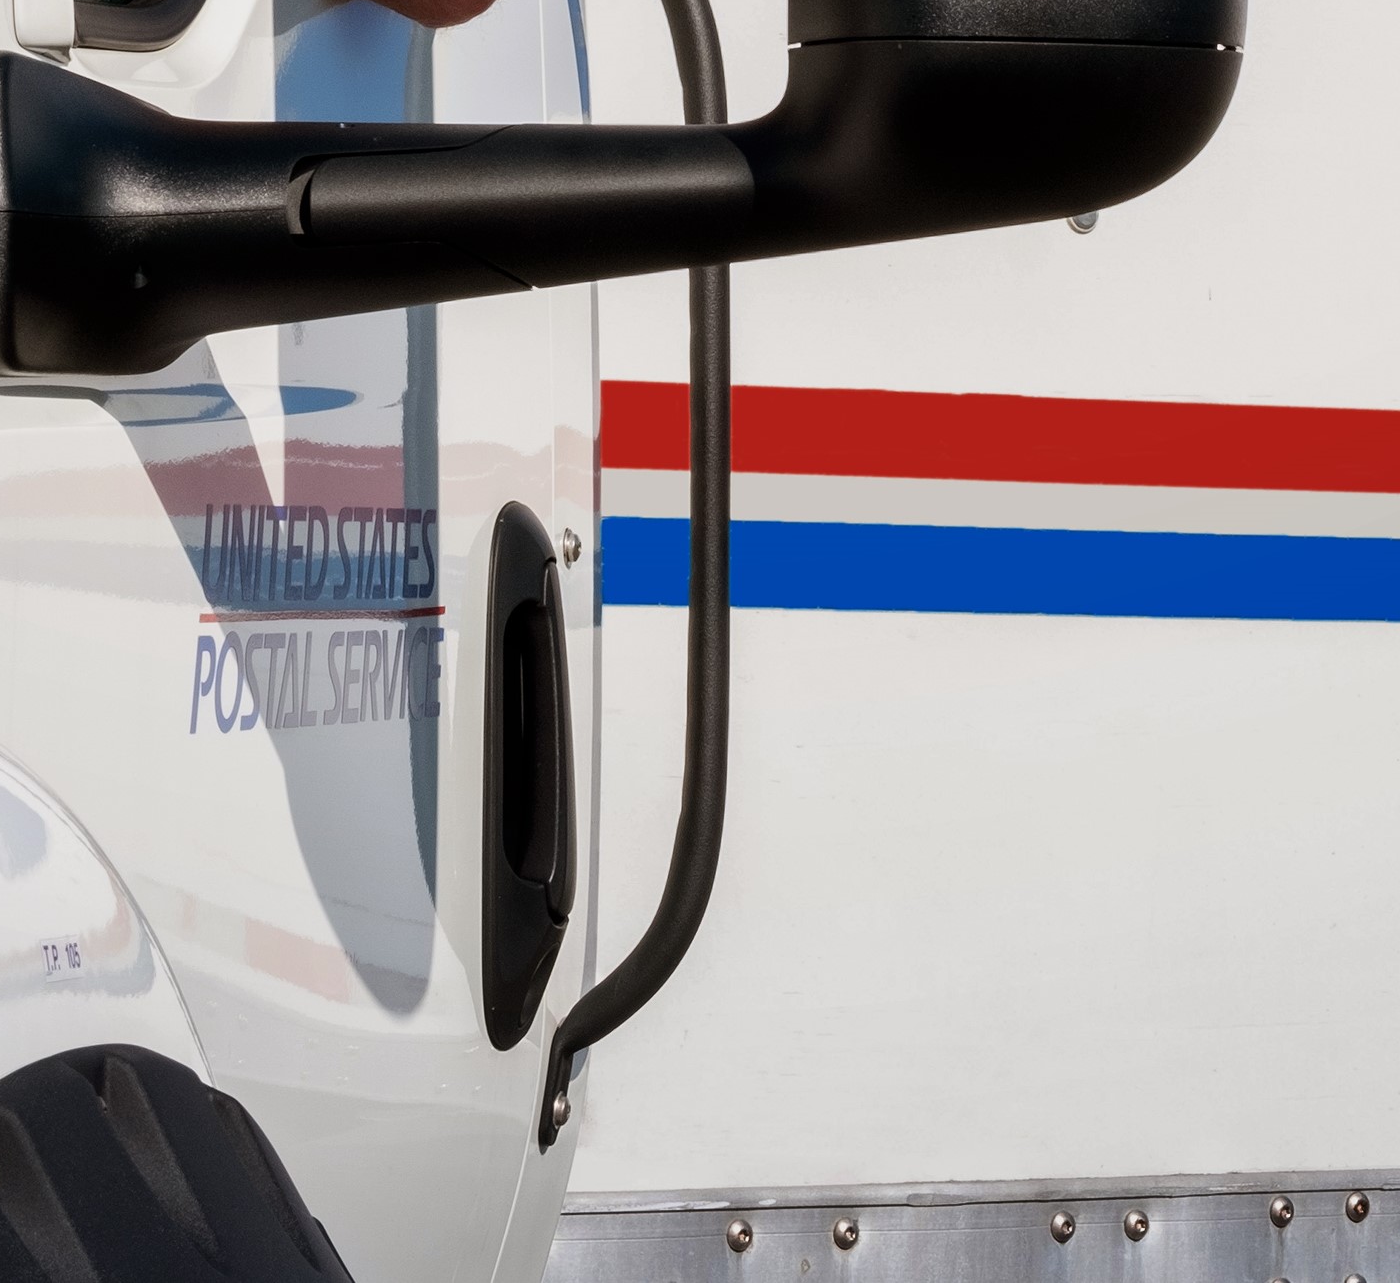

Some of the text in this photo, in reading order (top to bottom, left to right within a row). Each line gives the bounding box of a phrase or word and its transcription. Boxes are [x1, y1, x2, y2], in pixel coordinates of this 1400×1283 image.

[202, 503, 437, 602] UNITED STATES
[190, 626, 445, 735] POSTAL SERVICE
